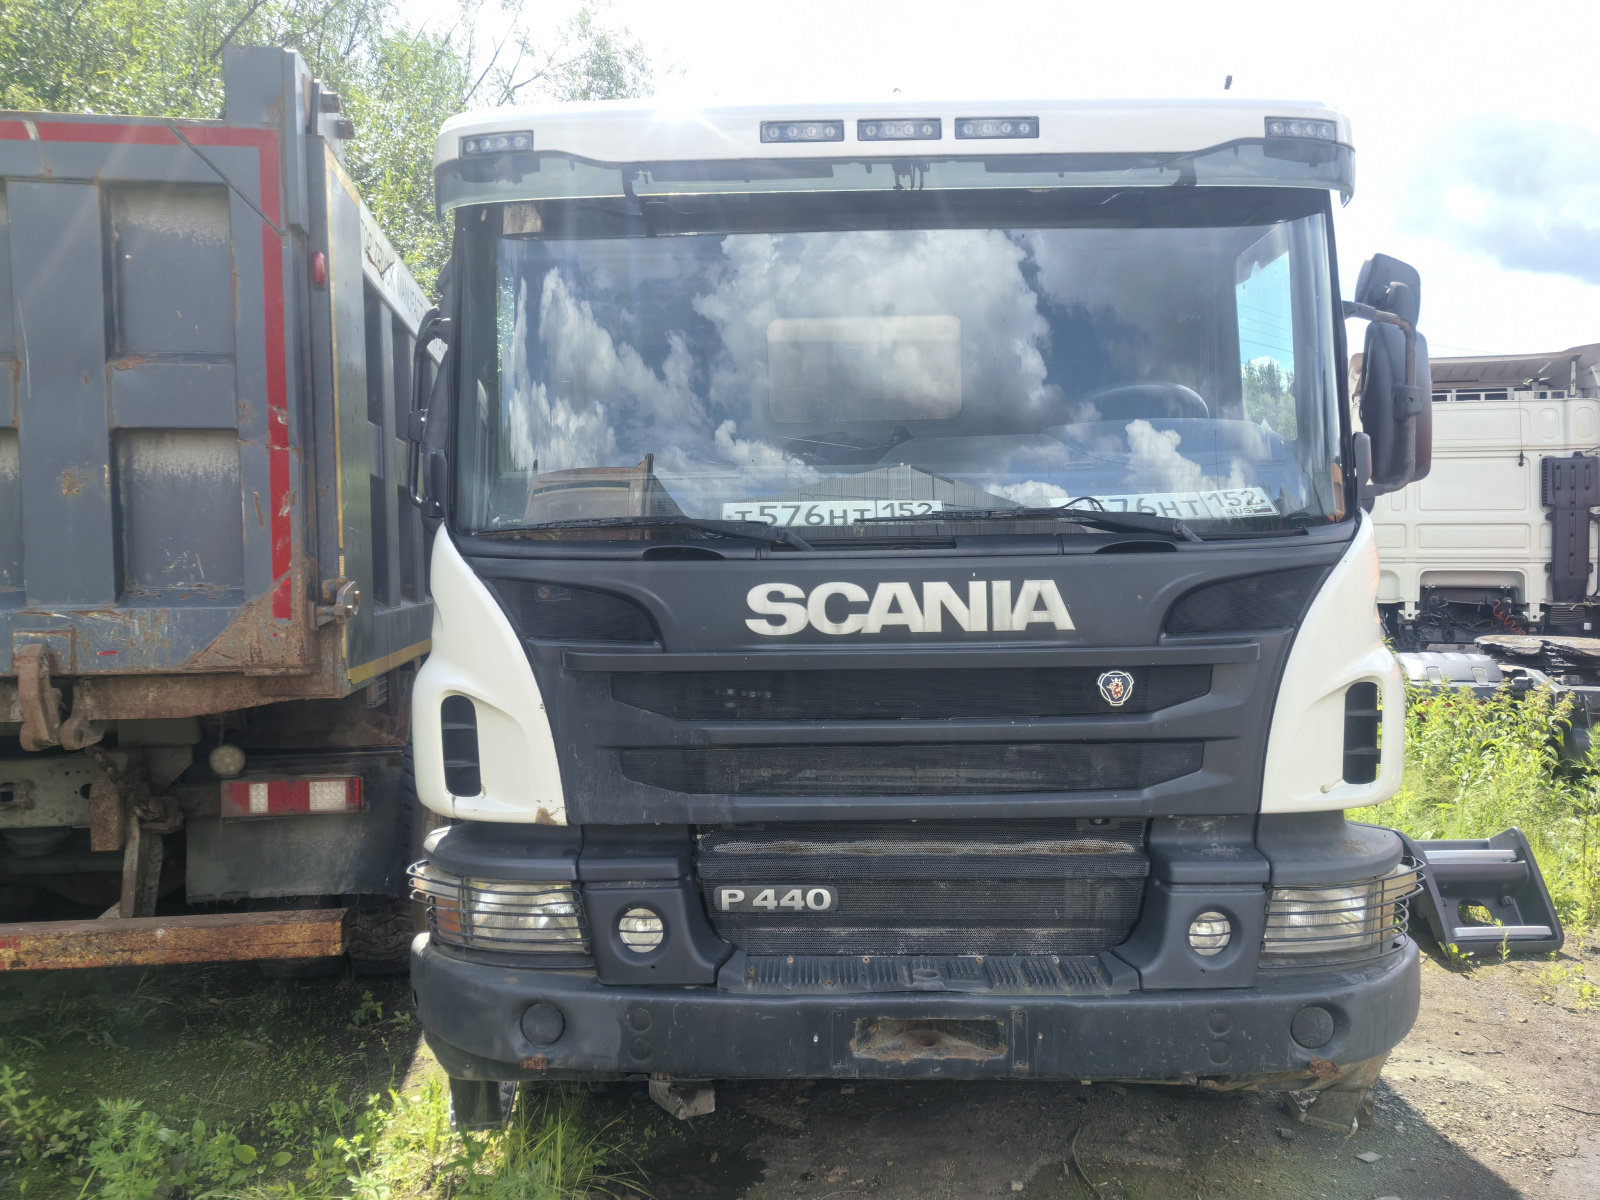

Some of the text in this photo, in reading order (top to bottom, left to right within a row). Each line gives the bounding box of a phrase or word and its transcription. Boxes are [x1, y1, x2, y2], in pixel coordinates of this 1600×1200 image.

[1226, 507, 1253, 515] RUS
[744, 579, 1077, 636] SCANIA
[721, 888, 832, 911] P 440
